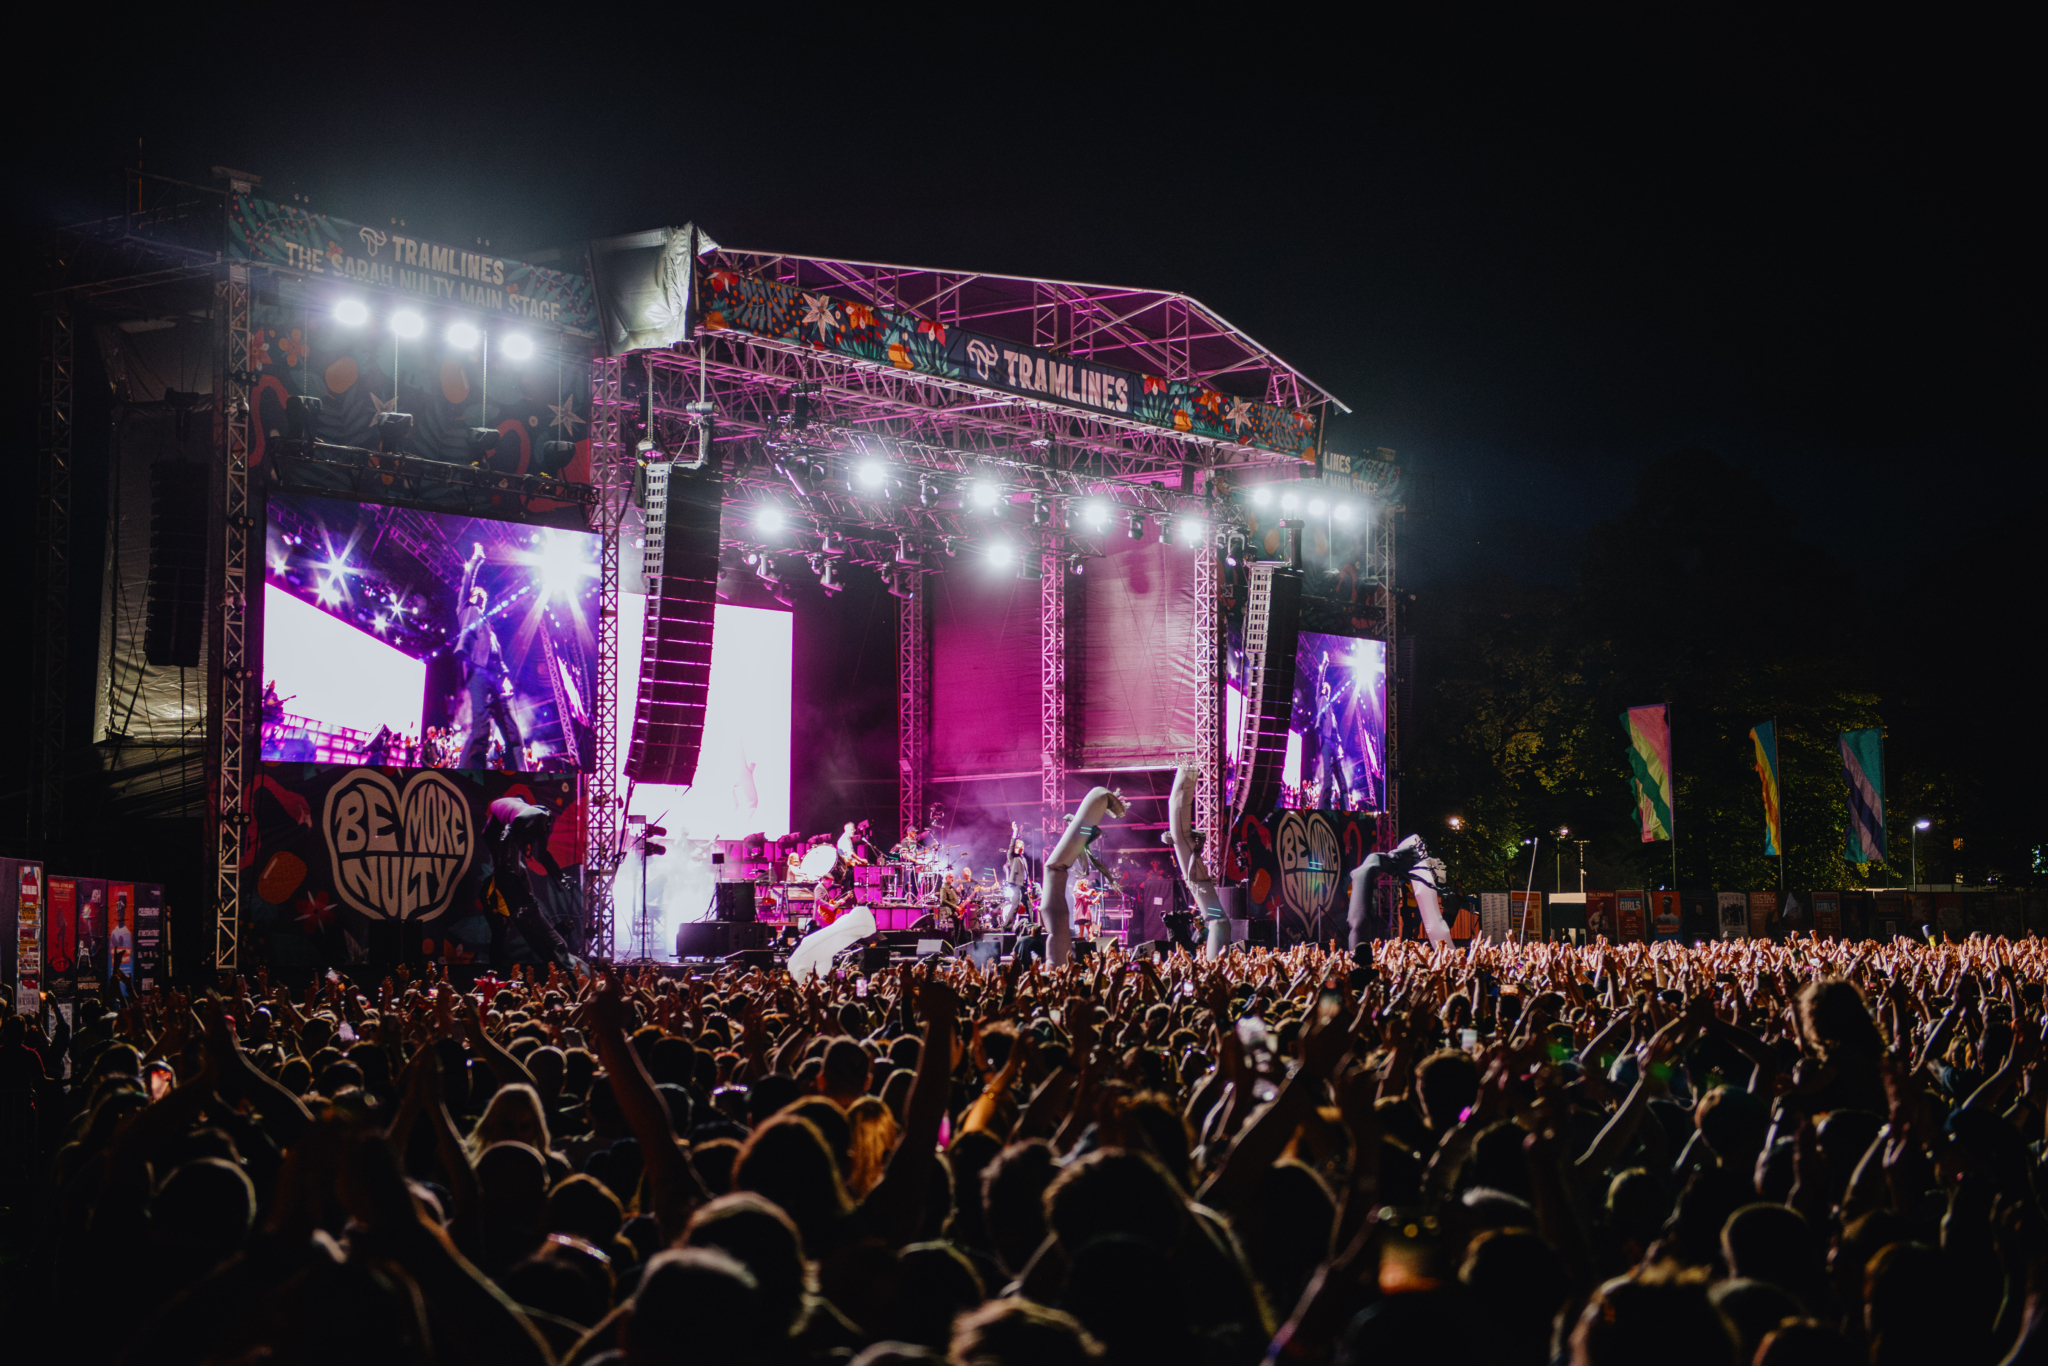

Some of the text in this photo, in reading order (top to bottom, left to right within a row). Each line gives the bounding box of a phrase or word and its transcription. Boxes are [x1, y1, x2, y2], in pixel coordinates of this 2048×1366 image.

[286, 241, 325, 274] THE
[331, 253, 394, 288] SARAH
[460, 282, 503, 310] MAIN
[508, 293, 561, 322] STAGE
[392, 235, 504, 286] TRAMLINES
[1003, 349, 1129, 413] TRAMLINES
[334, 783, 466, 856] BE MORE
[1282, 820, 1309, 870] BE
[341, 855, 459, 920] NULTY
